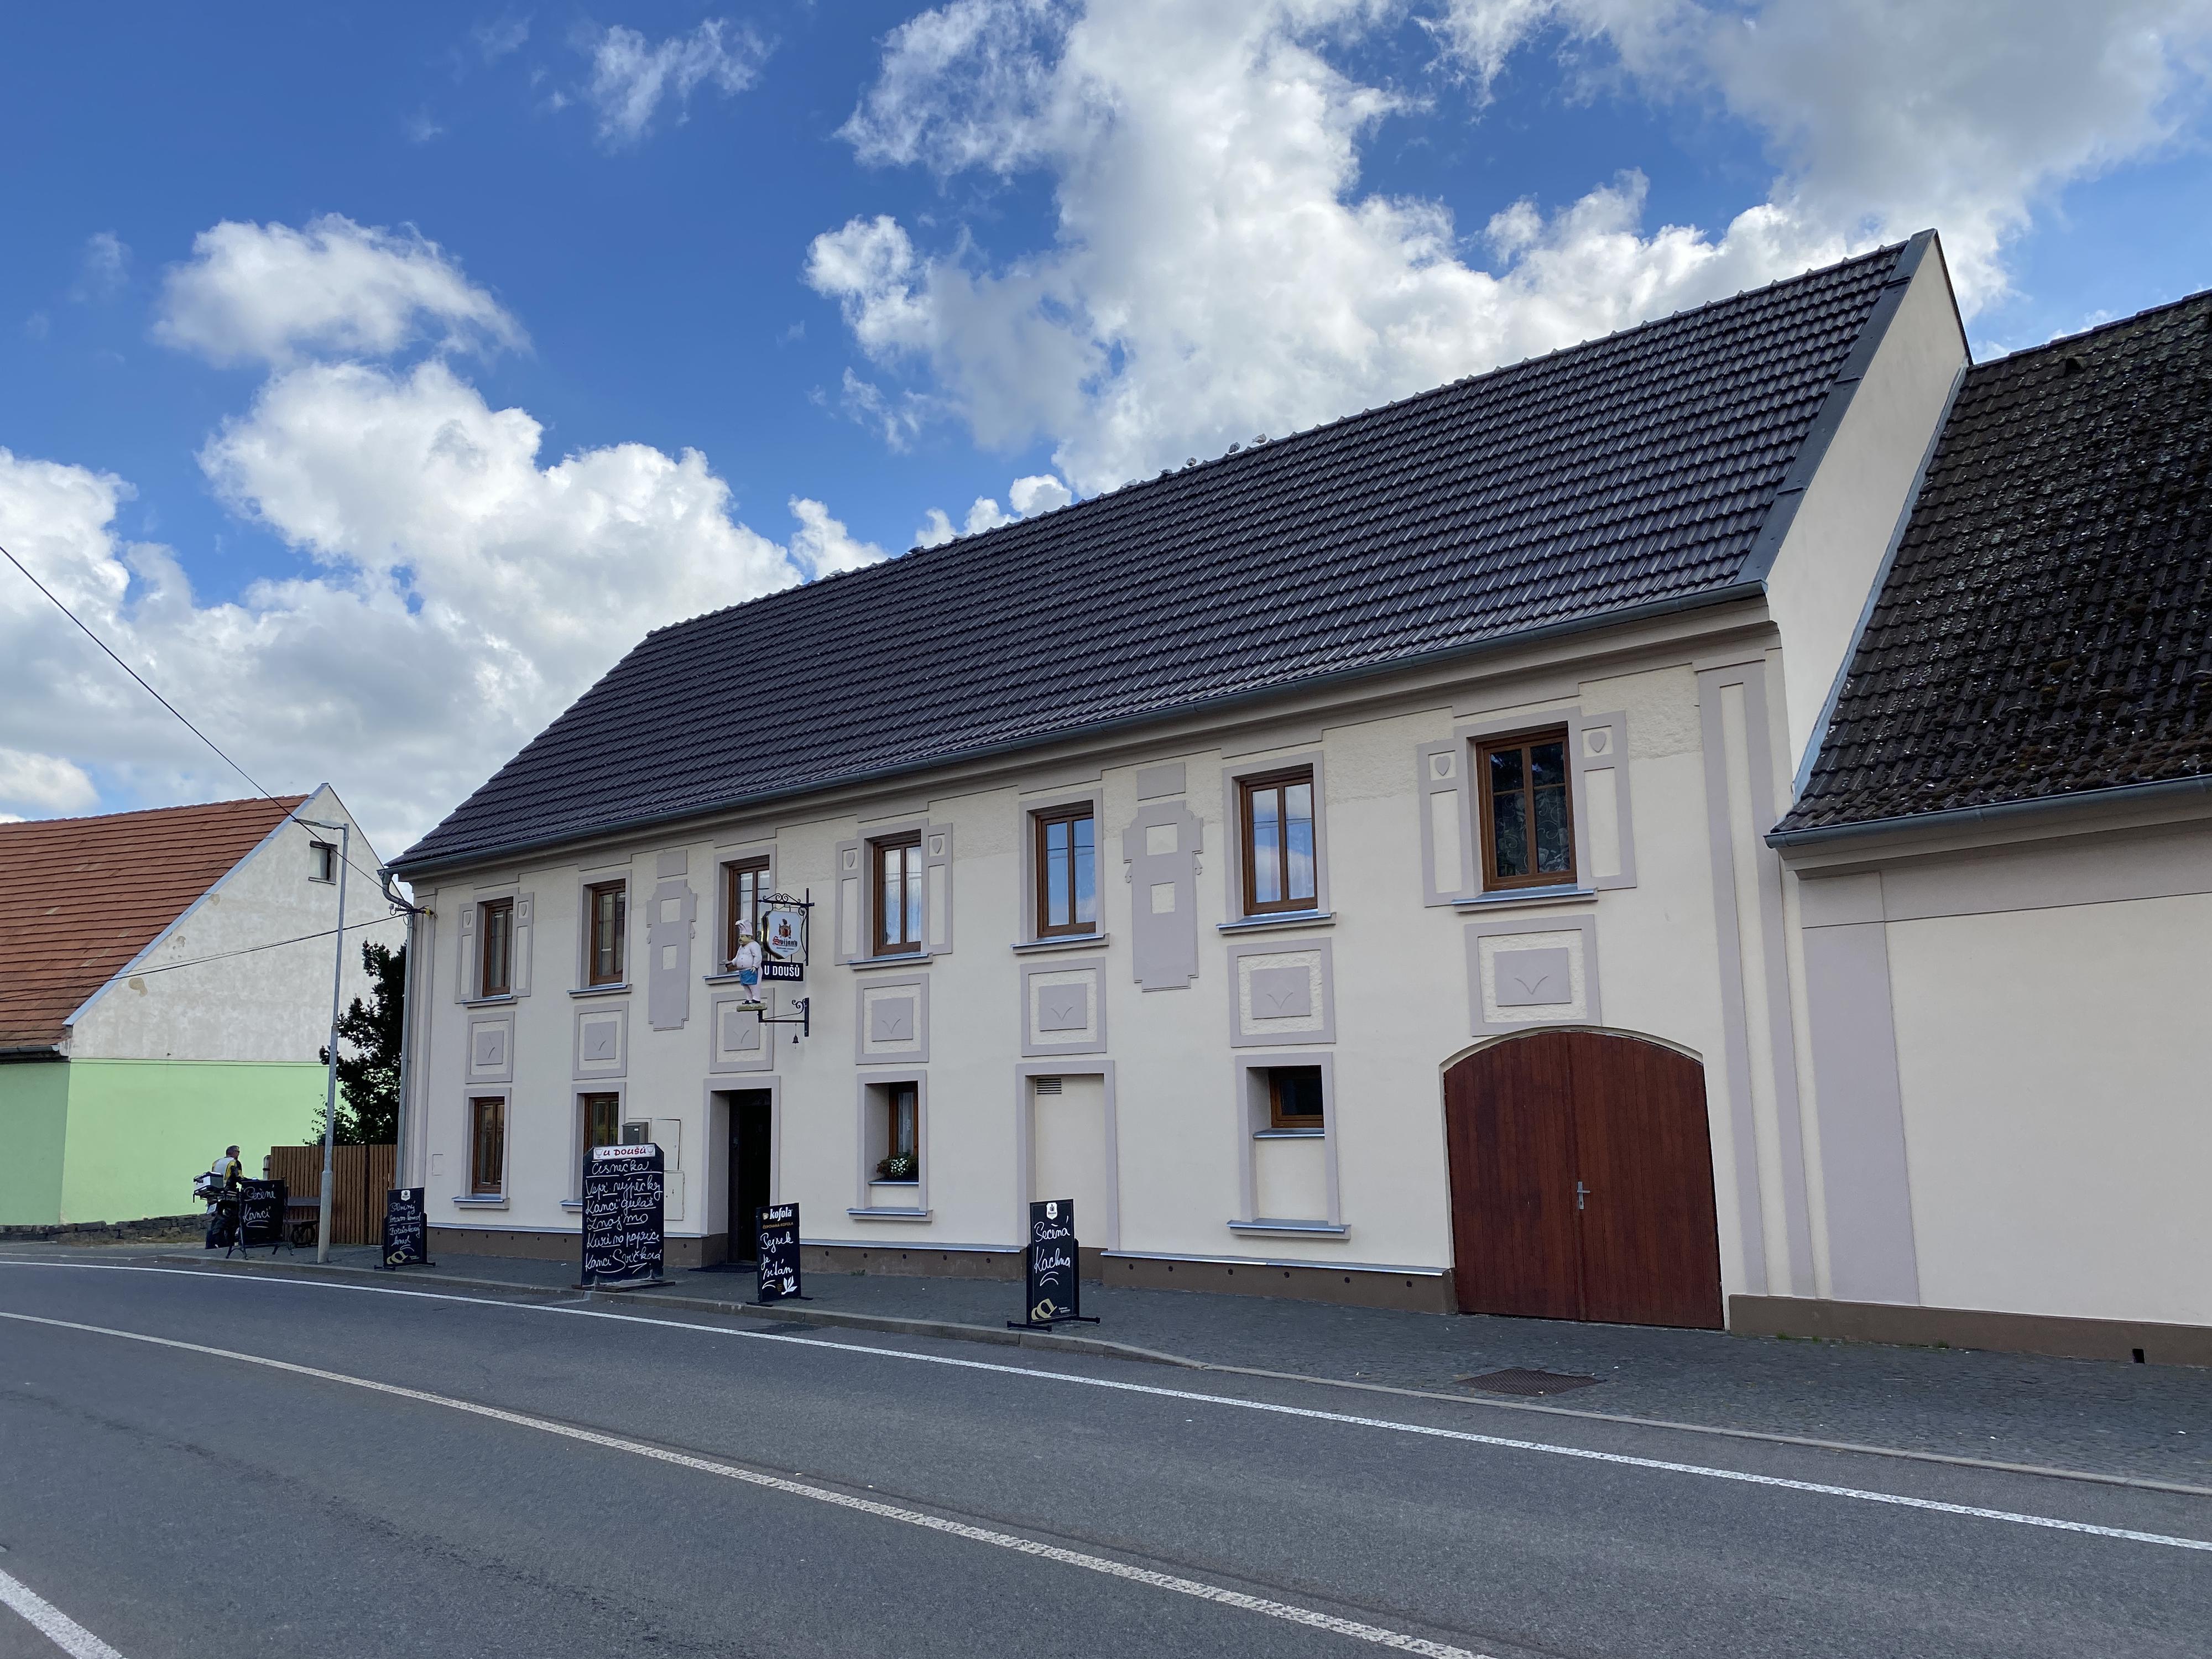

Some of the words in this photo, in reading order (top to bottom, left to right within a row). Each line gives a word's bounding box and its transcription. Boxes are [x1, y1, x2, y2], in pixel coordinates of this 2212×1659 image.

[773, 936, 797, 947] Svijany
[764, 965, 769, 975] U
[773, 964, 800, 977] DOUŠŮ
[614, 1146, 646, 1156] DOUŠŮ
[770, 1207, 792, 1222] kofola
[760, 1232, 794, 1253] Pejsek
[1034, 1246, 1071, 1274] Kachna
